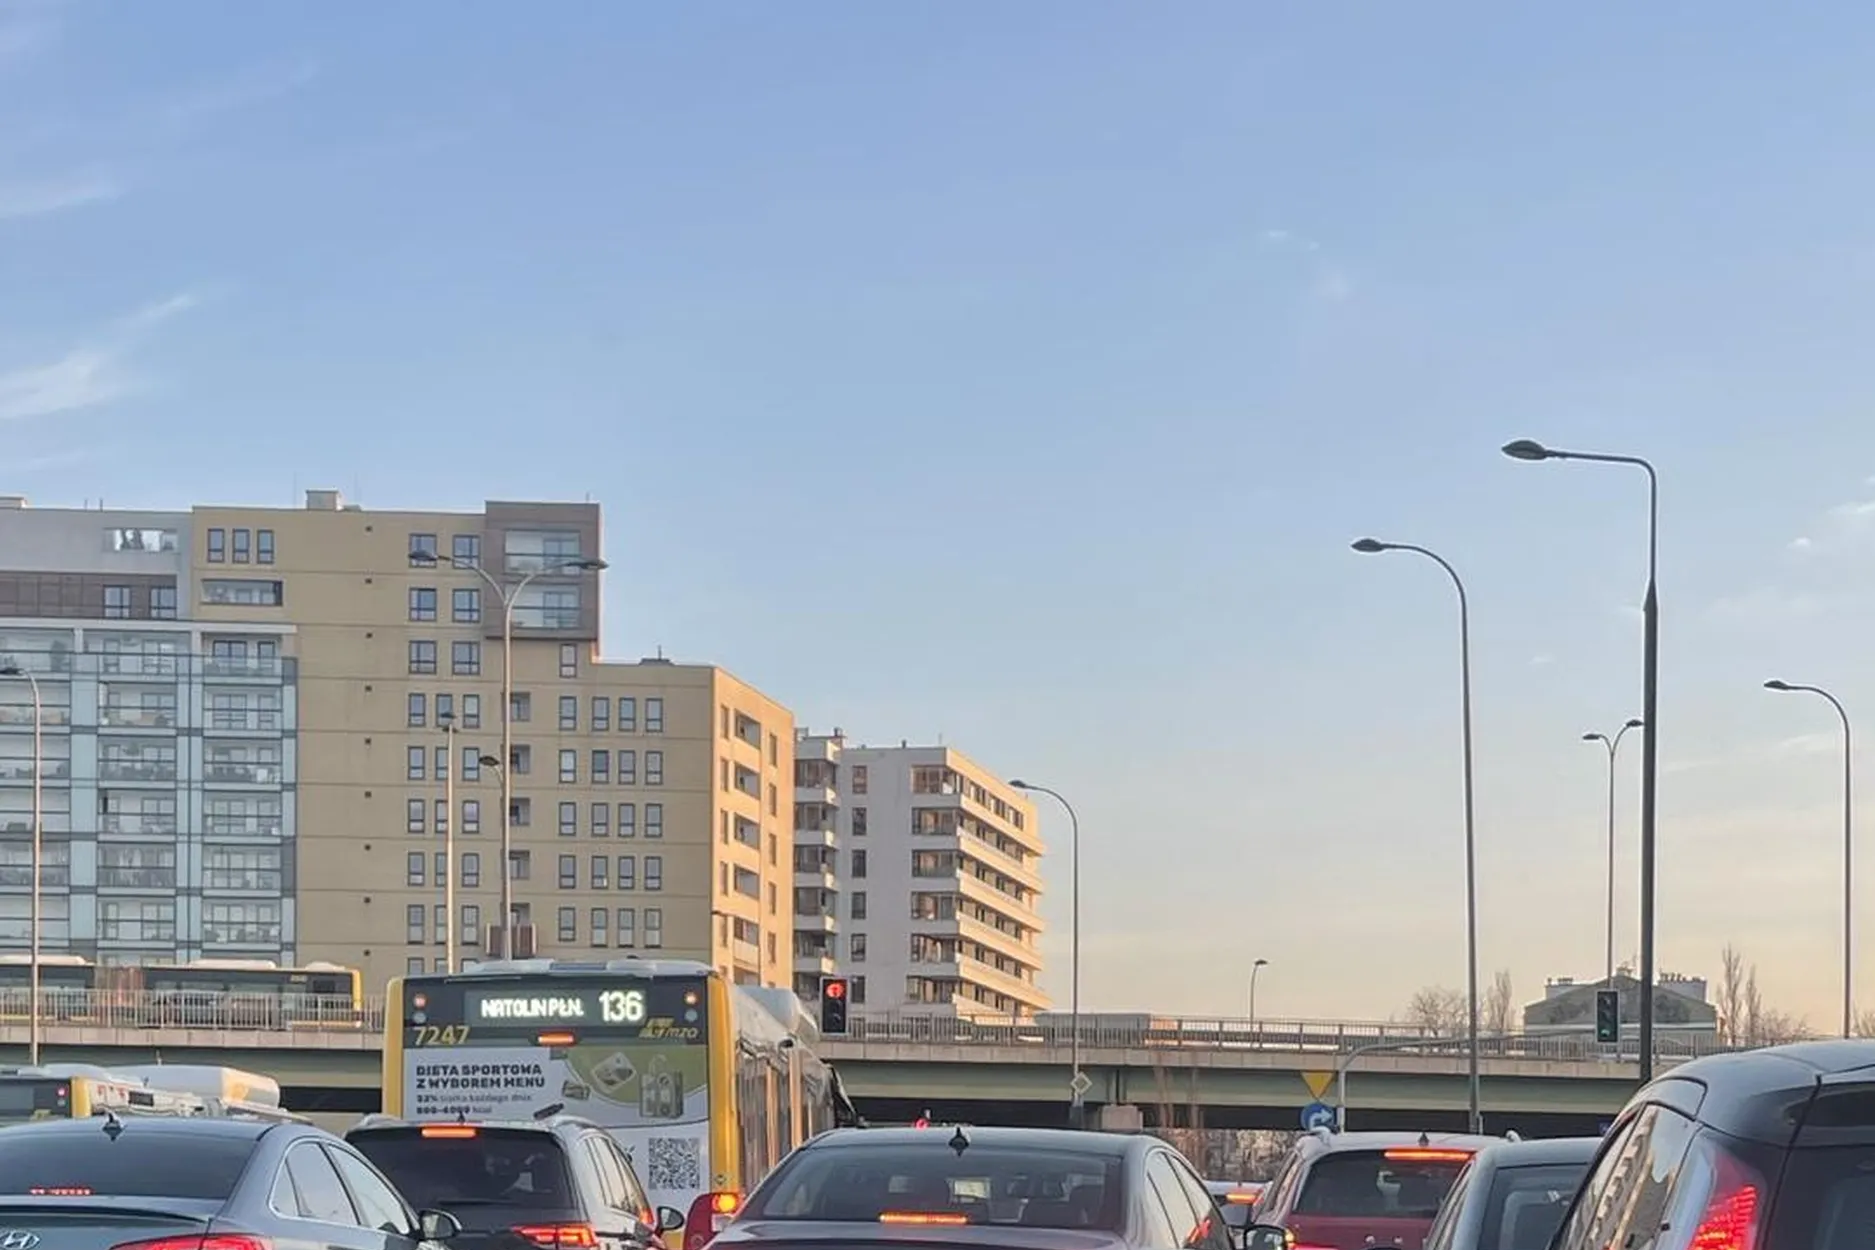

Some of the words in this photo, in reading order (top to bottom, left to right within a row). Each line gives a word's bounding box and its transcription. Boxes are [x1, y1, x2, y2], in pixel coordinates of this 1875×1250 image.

[480, 999, 548, 1018] NATOLIN
[599, 990, 644, 1022] 136
[413, 1026, 470, 1046] 7247
[416, 1065, 459, 1077] DIETA
[461, 1064, 543, 1076] SPORTOWA
[416, 1078, 425, 1089] Z
[428, 1077, 501, 1089] WYBOREM
[503, 1076, 545, 1088] MENU
